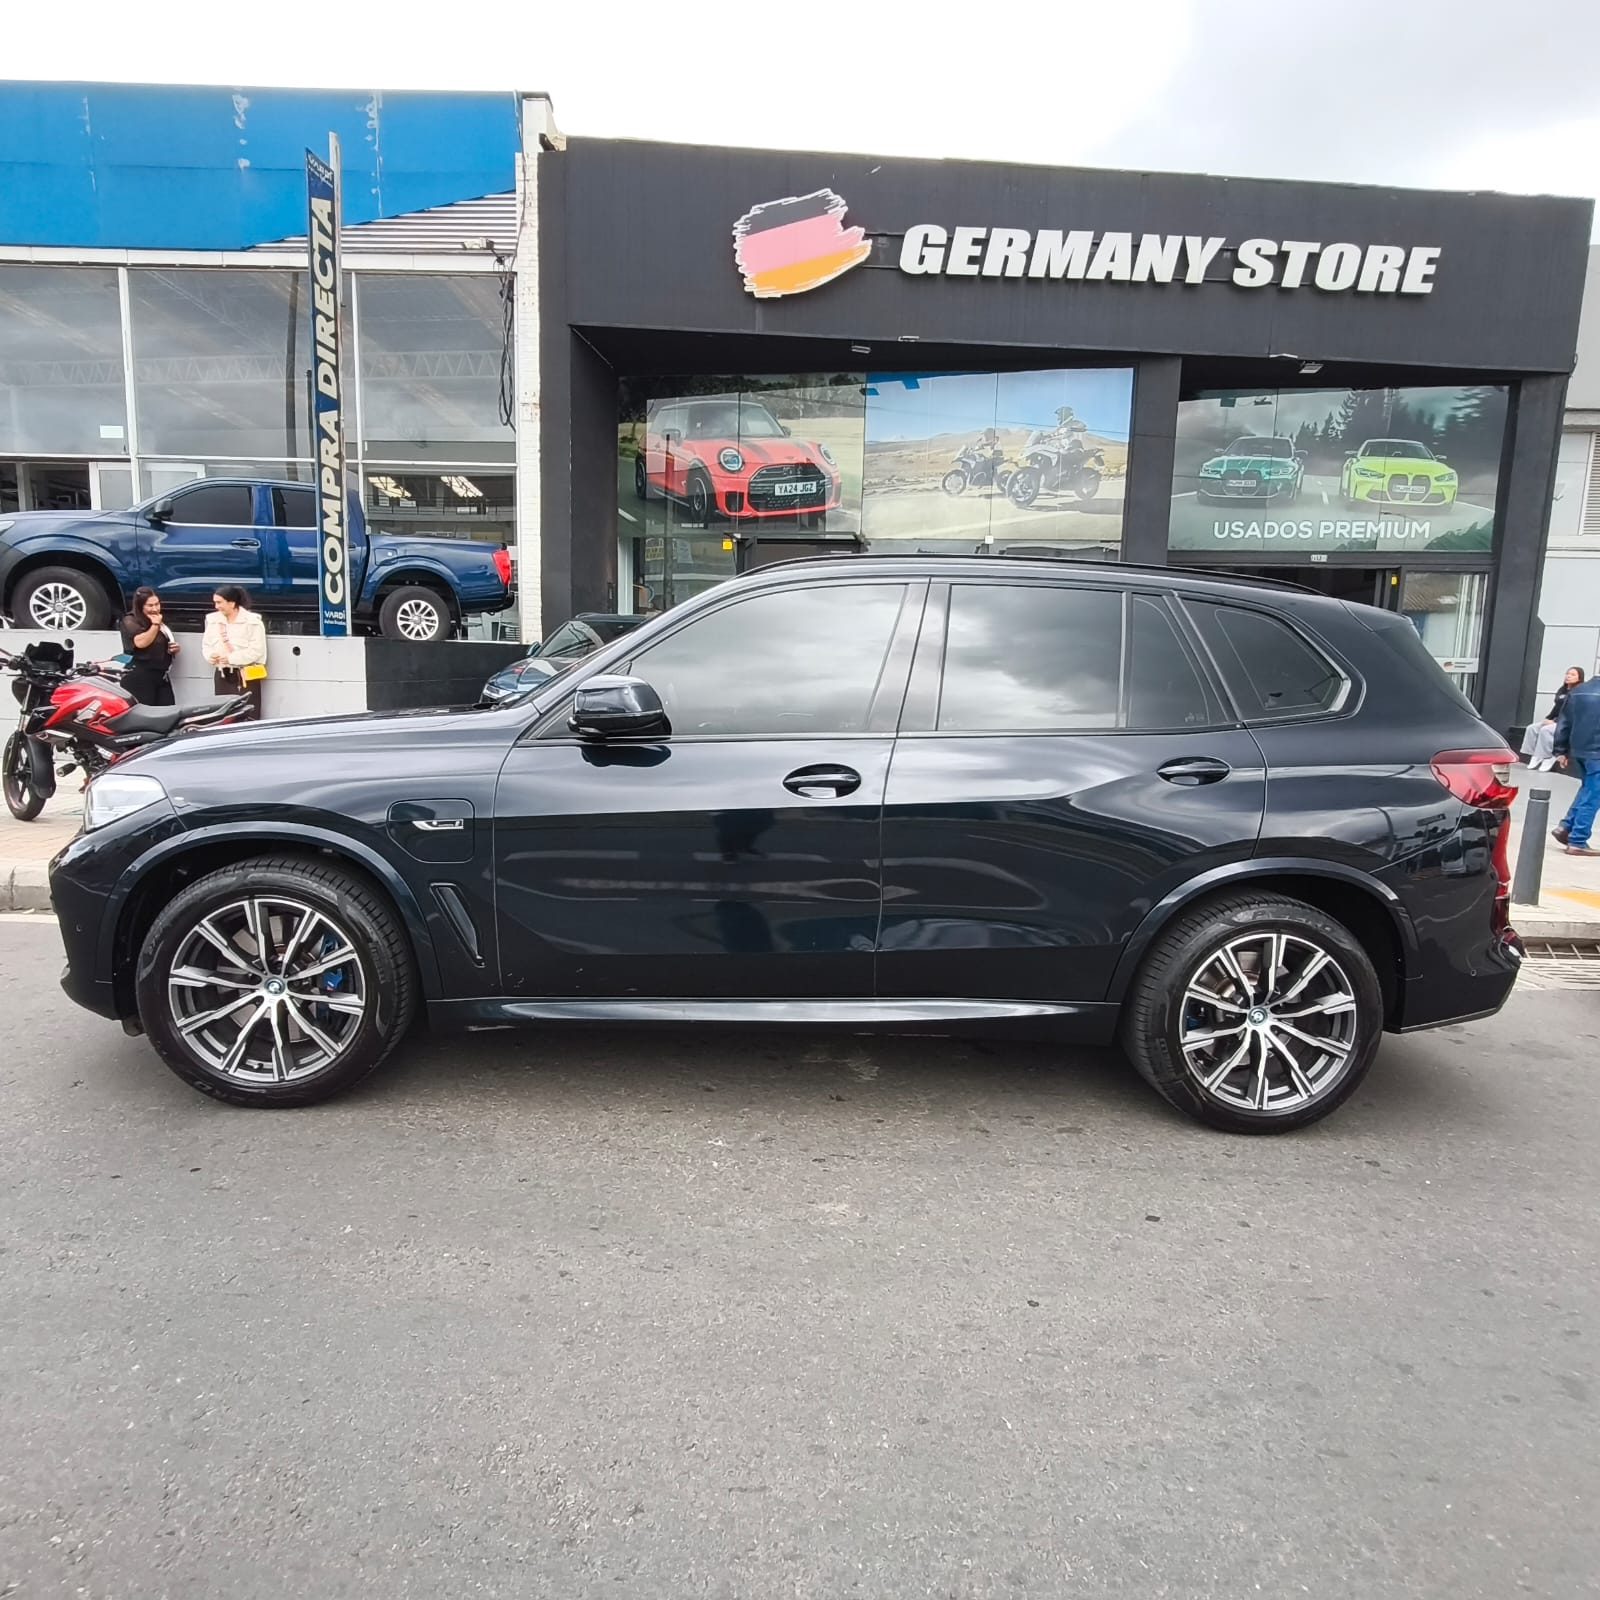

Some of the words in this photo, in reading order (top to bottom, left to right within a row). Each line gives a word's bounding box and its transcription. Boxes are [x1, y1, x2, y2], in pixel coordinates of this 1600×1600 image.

[900, 224, 1226, 284] GERMANY
[1233, 239, 1442, 293] STORE
[311, 197, 338, 400] DIRECTA
[319, 410, 344, 604] COMPRA
[778, 484, 798, 494] YA24
[800, 483, 814, 492] JGZ
[1213, 520, 1313, 539] USADOS
[1319, 520, 1431, 539] PREMIUM
